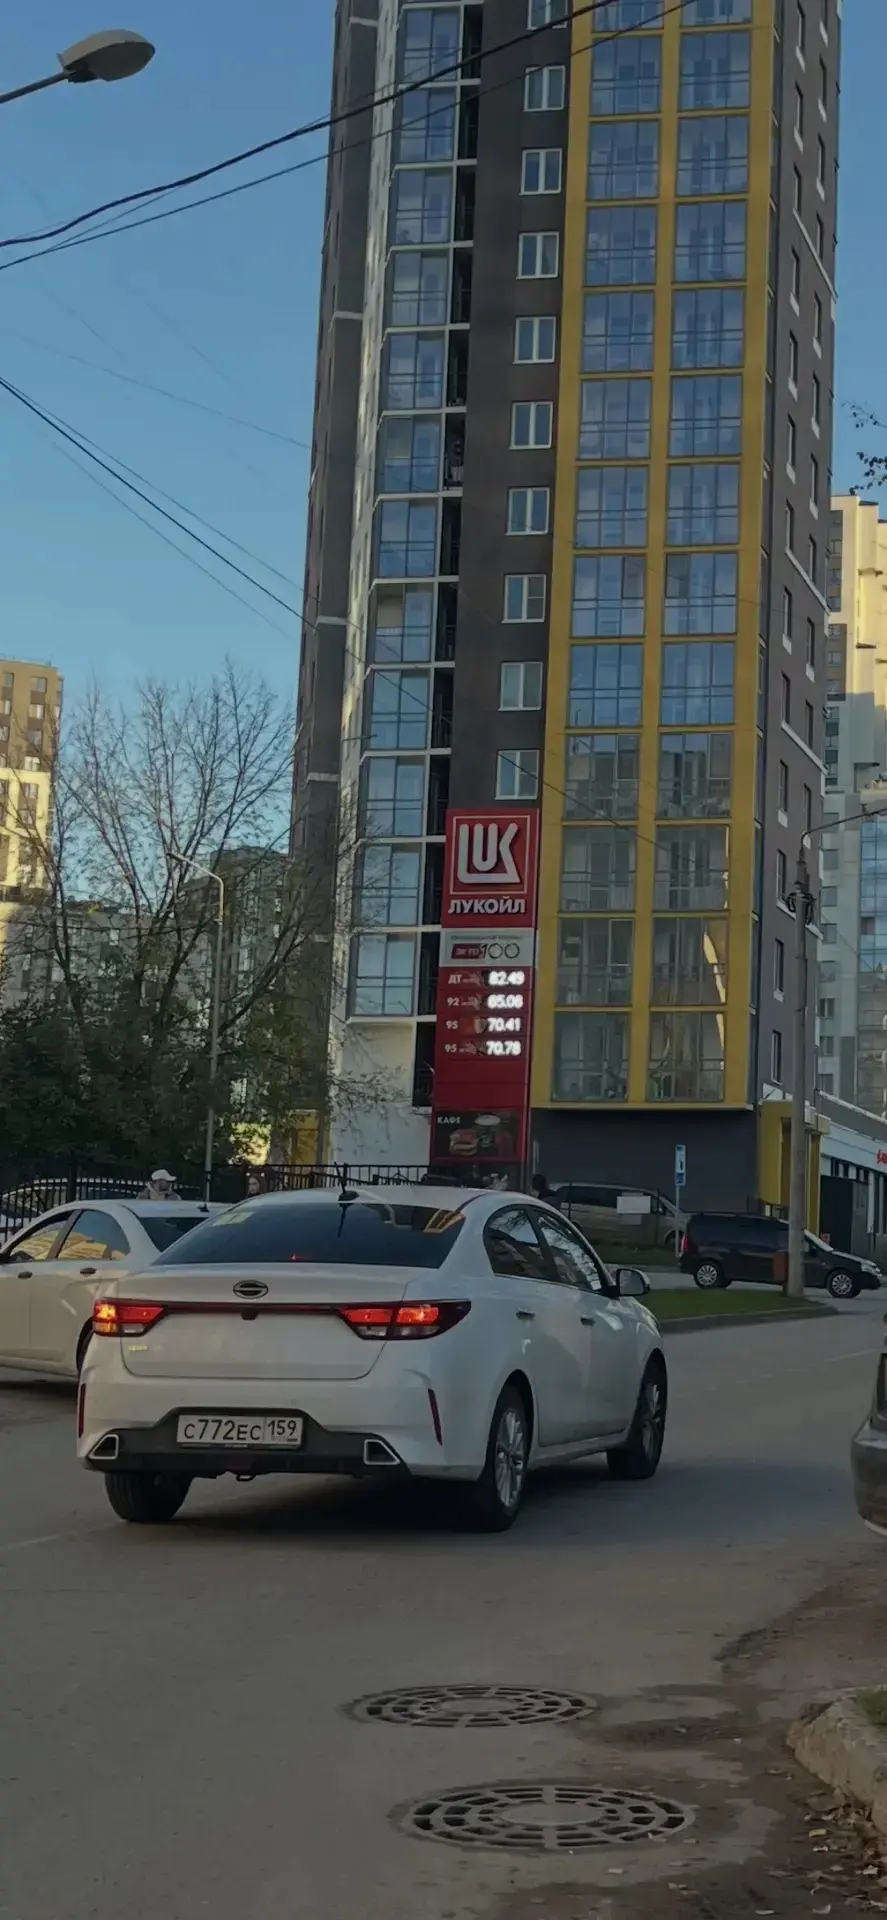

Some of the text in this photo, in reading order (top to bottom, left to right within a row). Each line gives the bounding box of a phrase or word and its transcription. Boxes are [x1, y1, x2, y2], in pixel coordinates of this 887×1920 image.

[448, 896, 525, 914] ЛУКОЙЛ
[480, 943, 520, 959] 100
[447, 997, 459, 1006] 92
[446, 1017, 521, 1032] 95 70.41
[445, 1040, 521, 1056] 95 70.78
[437, 1116, 460, 1124] КАФЕ
[267, 1420, 297, 1436] 159
